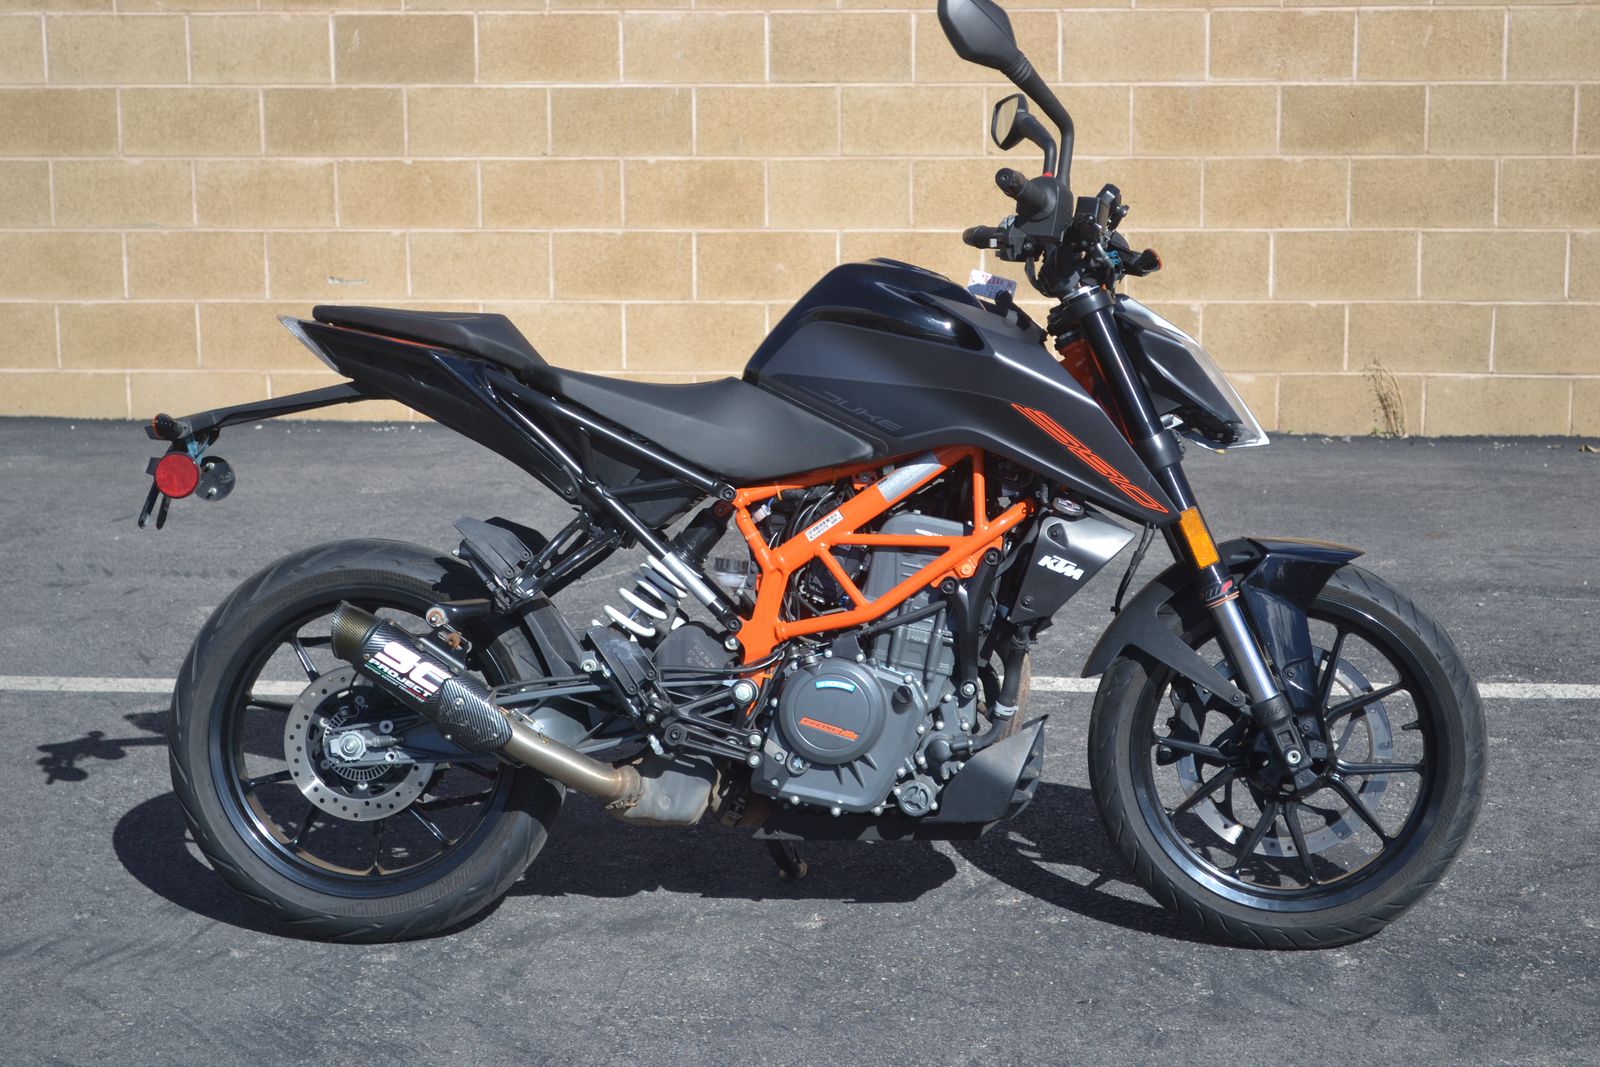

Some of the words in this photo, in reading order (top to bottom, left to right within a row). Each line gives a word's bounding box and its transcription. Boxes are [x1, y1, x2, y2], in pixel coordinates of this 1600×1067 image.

[818, 390, 904, 432] DUKE
[1037, 555, 1085, 581] KTM
[368, 657, 433, 698] PROJECT
